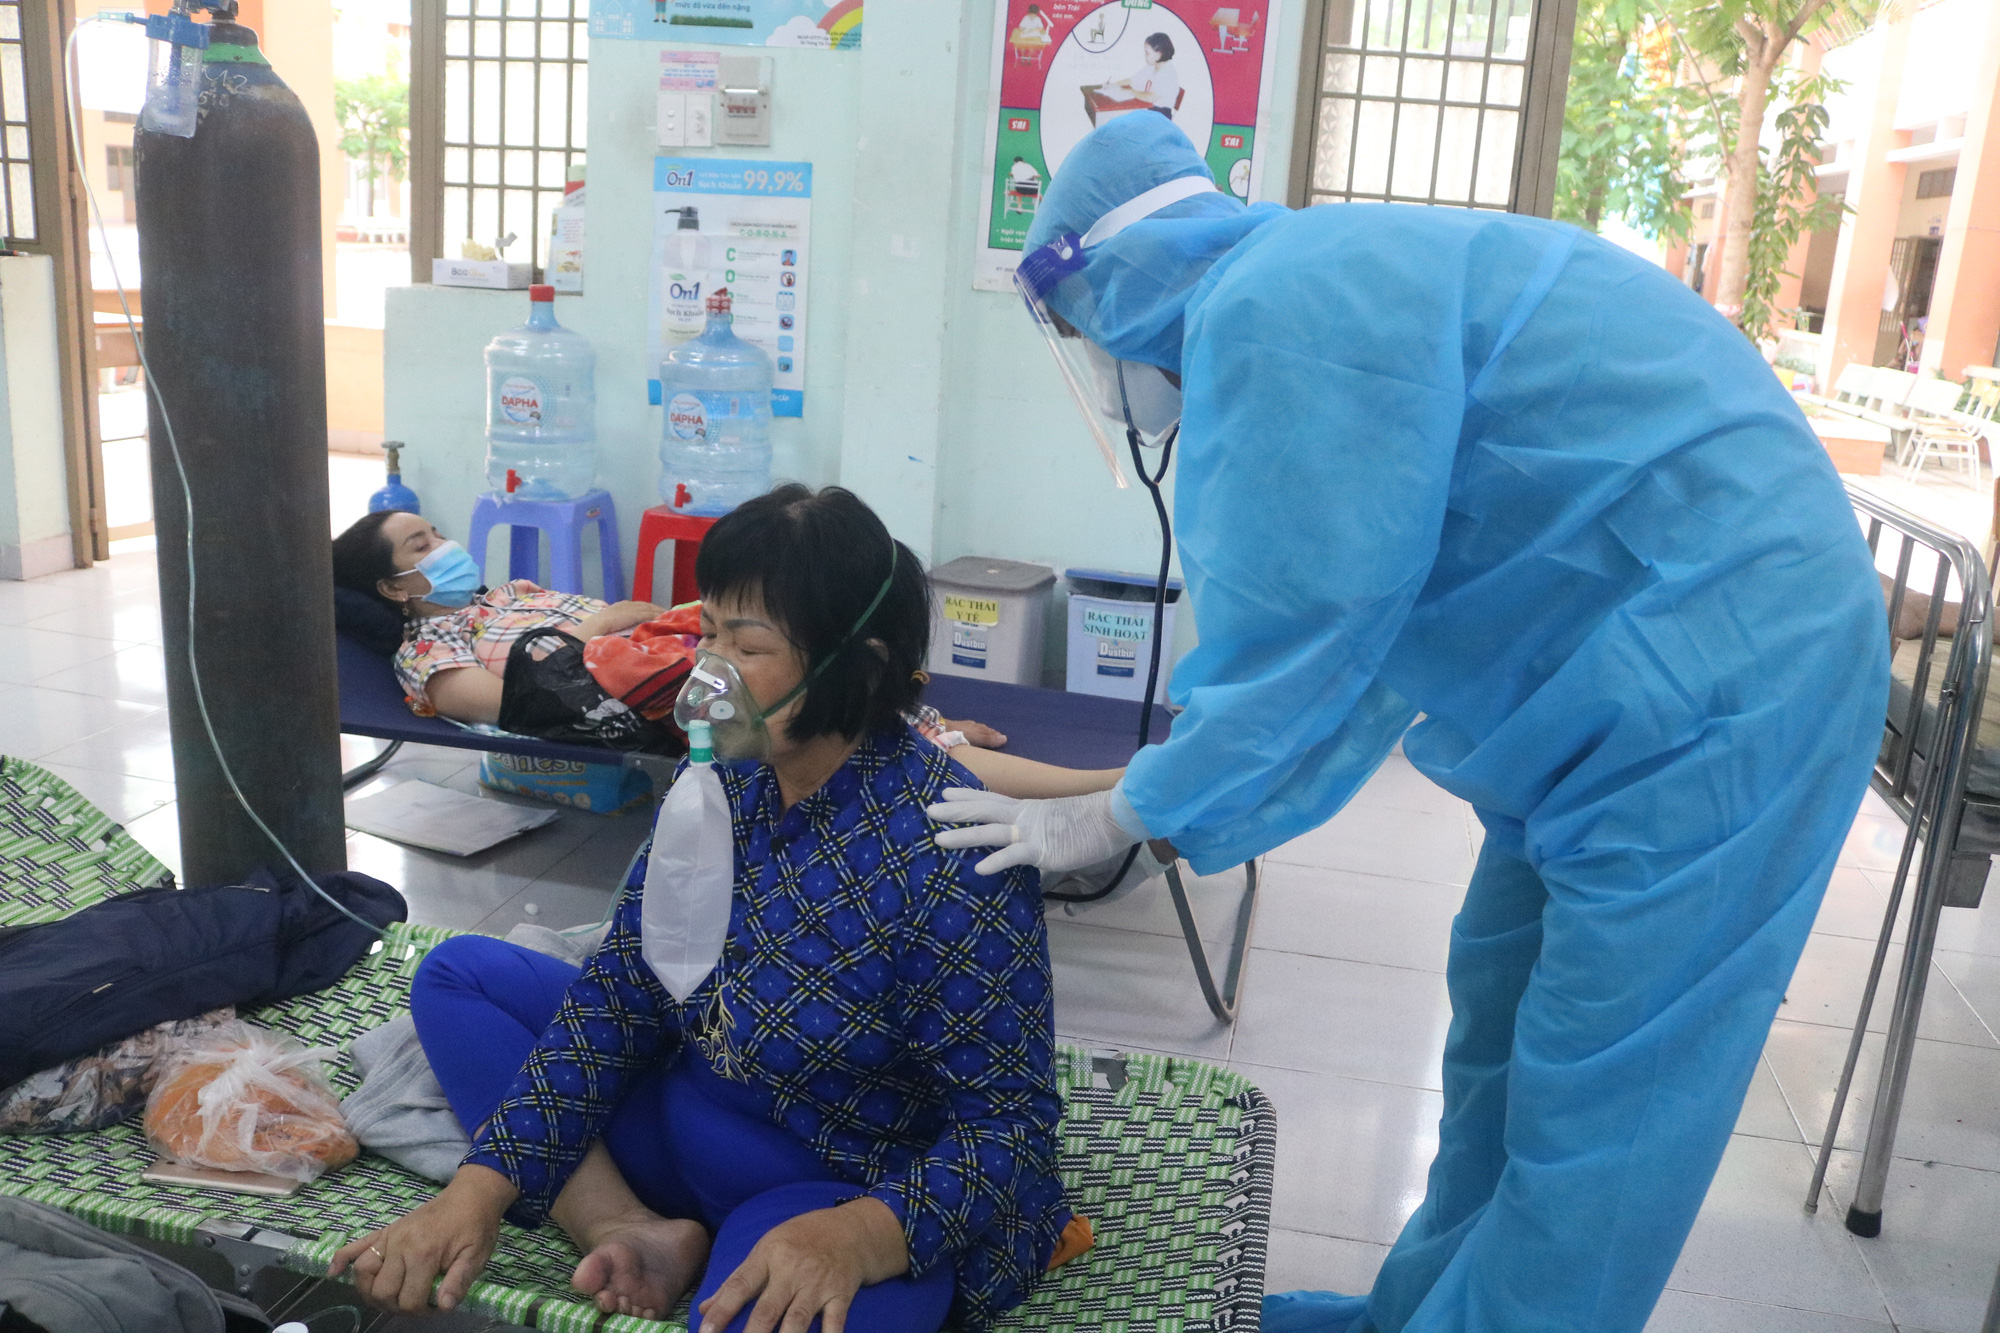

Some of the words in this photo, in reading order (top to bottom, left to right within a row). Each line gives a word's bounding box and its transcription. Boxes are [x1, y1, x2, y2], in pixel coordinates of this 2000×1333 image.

[1012, 120, 1026, 129] SAI
[1224, 136, 1240, 147] SAI
[667, 170, 695, 187] On1
[743, 169, 804, 193] 99,9%
[726, 247, 736, 261] C
[670, 281, 700, 300] On1
[501, 395, 538, 408] DAPHA
[670, 412, 703, 425] DAPHA
[956, 610, 964, 620] Y
[1088, 610, 1112, 624] RÁC
[1114, 614, 1144, 627] THẢI
[954, 631, 986, 649] Dustbin
[1084, 623, 1111, 636] SINH
[1114, 628, 1148, 641] HOẠT
[1099, 642, 1135, 658] Dustbin
